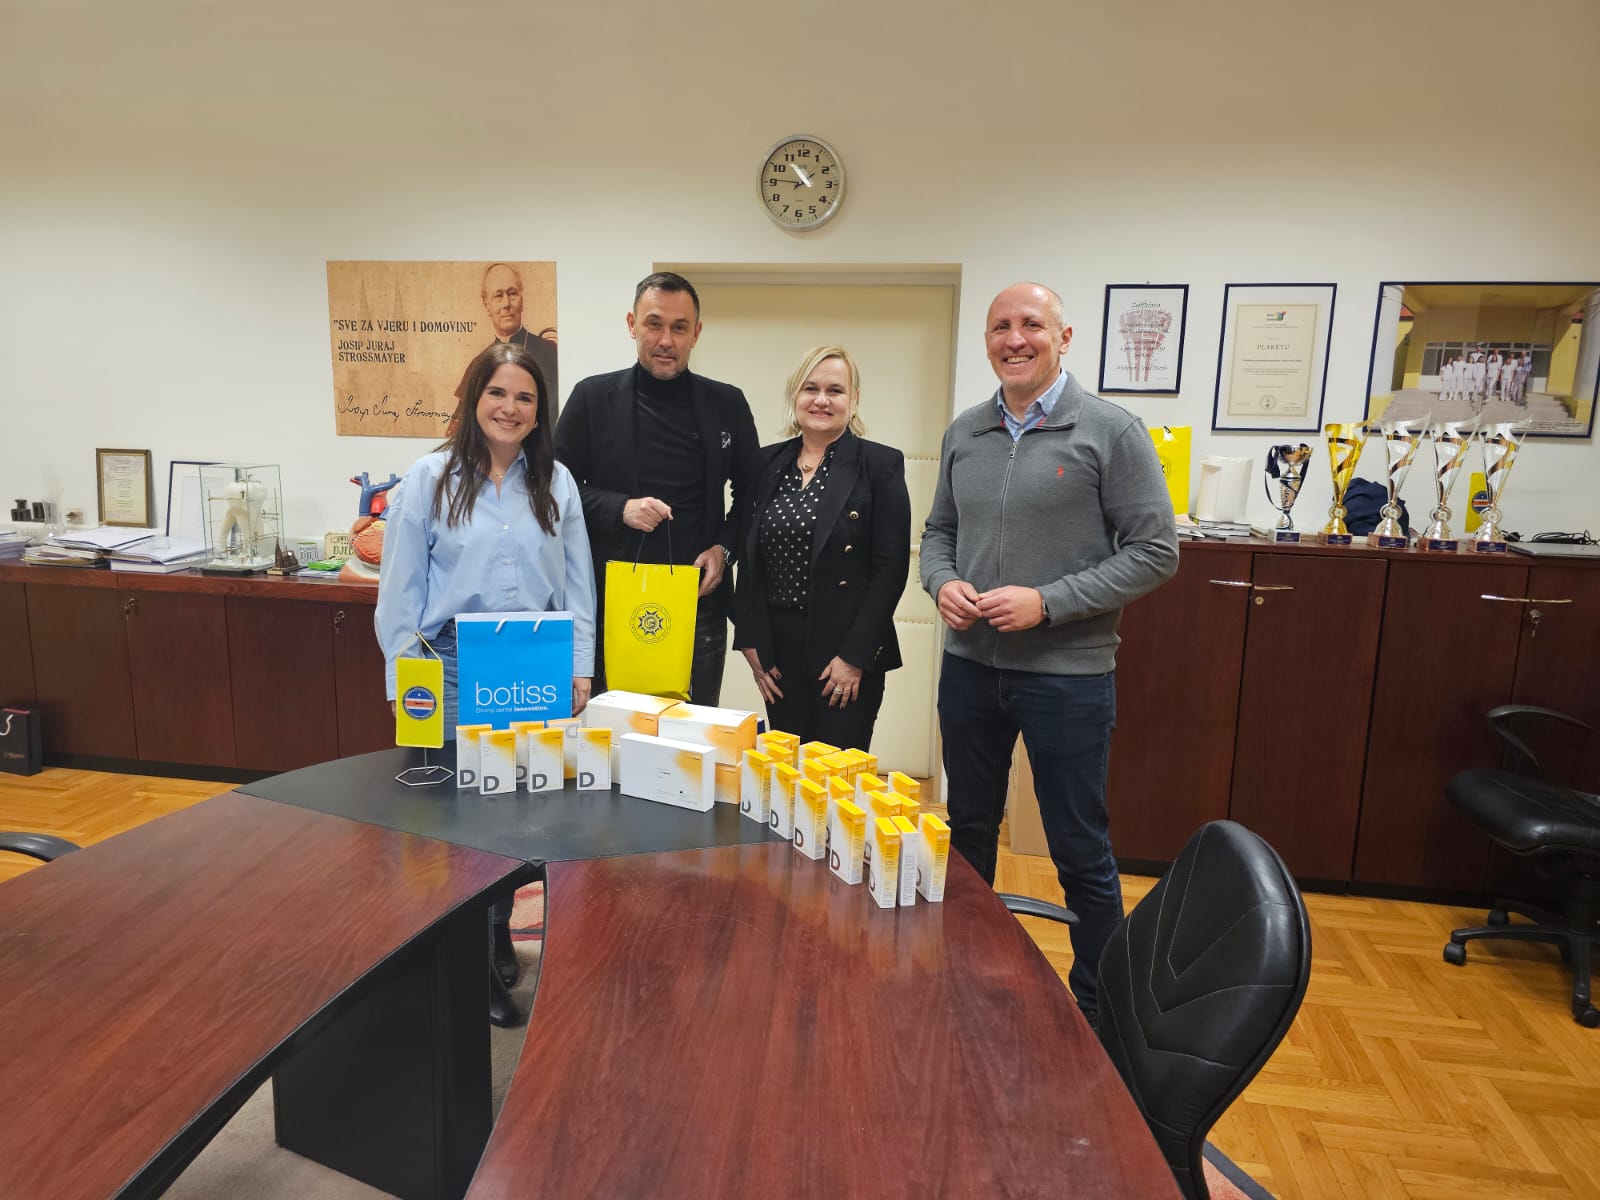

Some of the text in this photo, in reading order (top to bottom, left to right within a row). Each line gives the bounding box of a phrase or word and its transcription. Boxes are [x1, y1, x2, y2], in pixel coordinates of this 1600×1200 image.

[361, 319, 373, 332] ZA
[378, 320, 409, 332] VJERU
[412, 320, 417, 332] I
[338, 340, 395, 351] JOSIP JURAJ
[338, 351, 406, 363] STROSSMAYER
[475, 680, 558, 706] botiss
[460, 769, 476, 786] D
[483, 775, 500, 793] D
[532, 773, 548, 790] D
[580, 771, 595, 788] D
[770, 808, 779, 828] D
[794, 826, 804, 848] D
[830, 849, 840, 871] D
